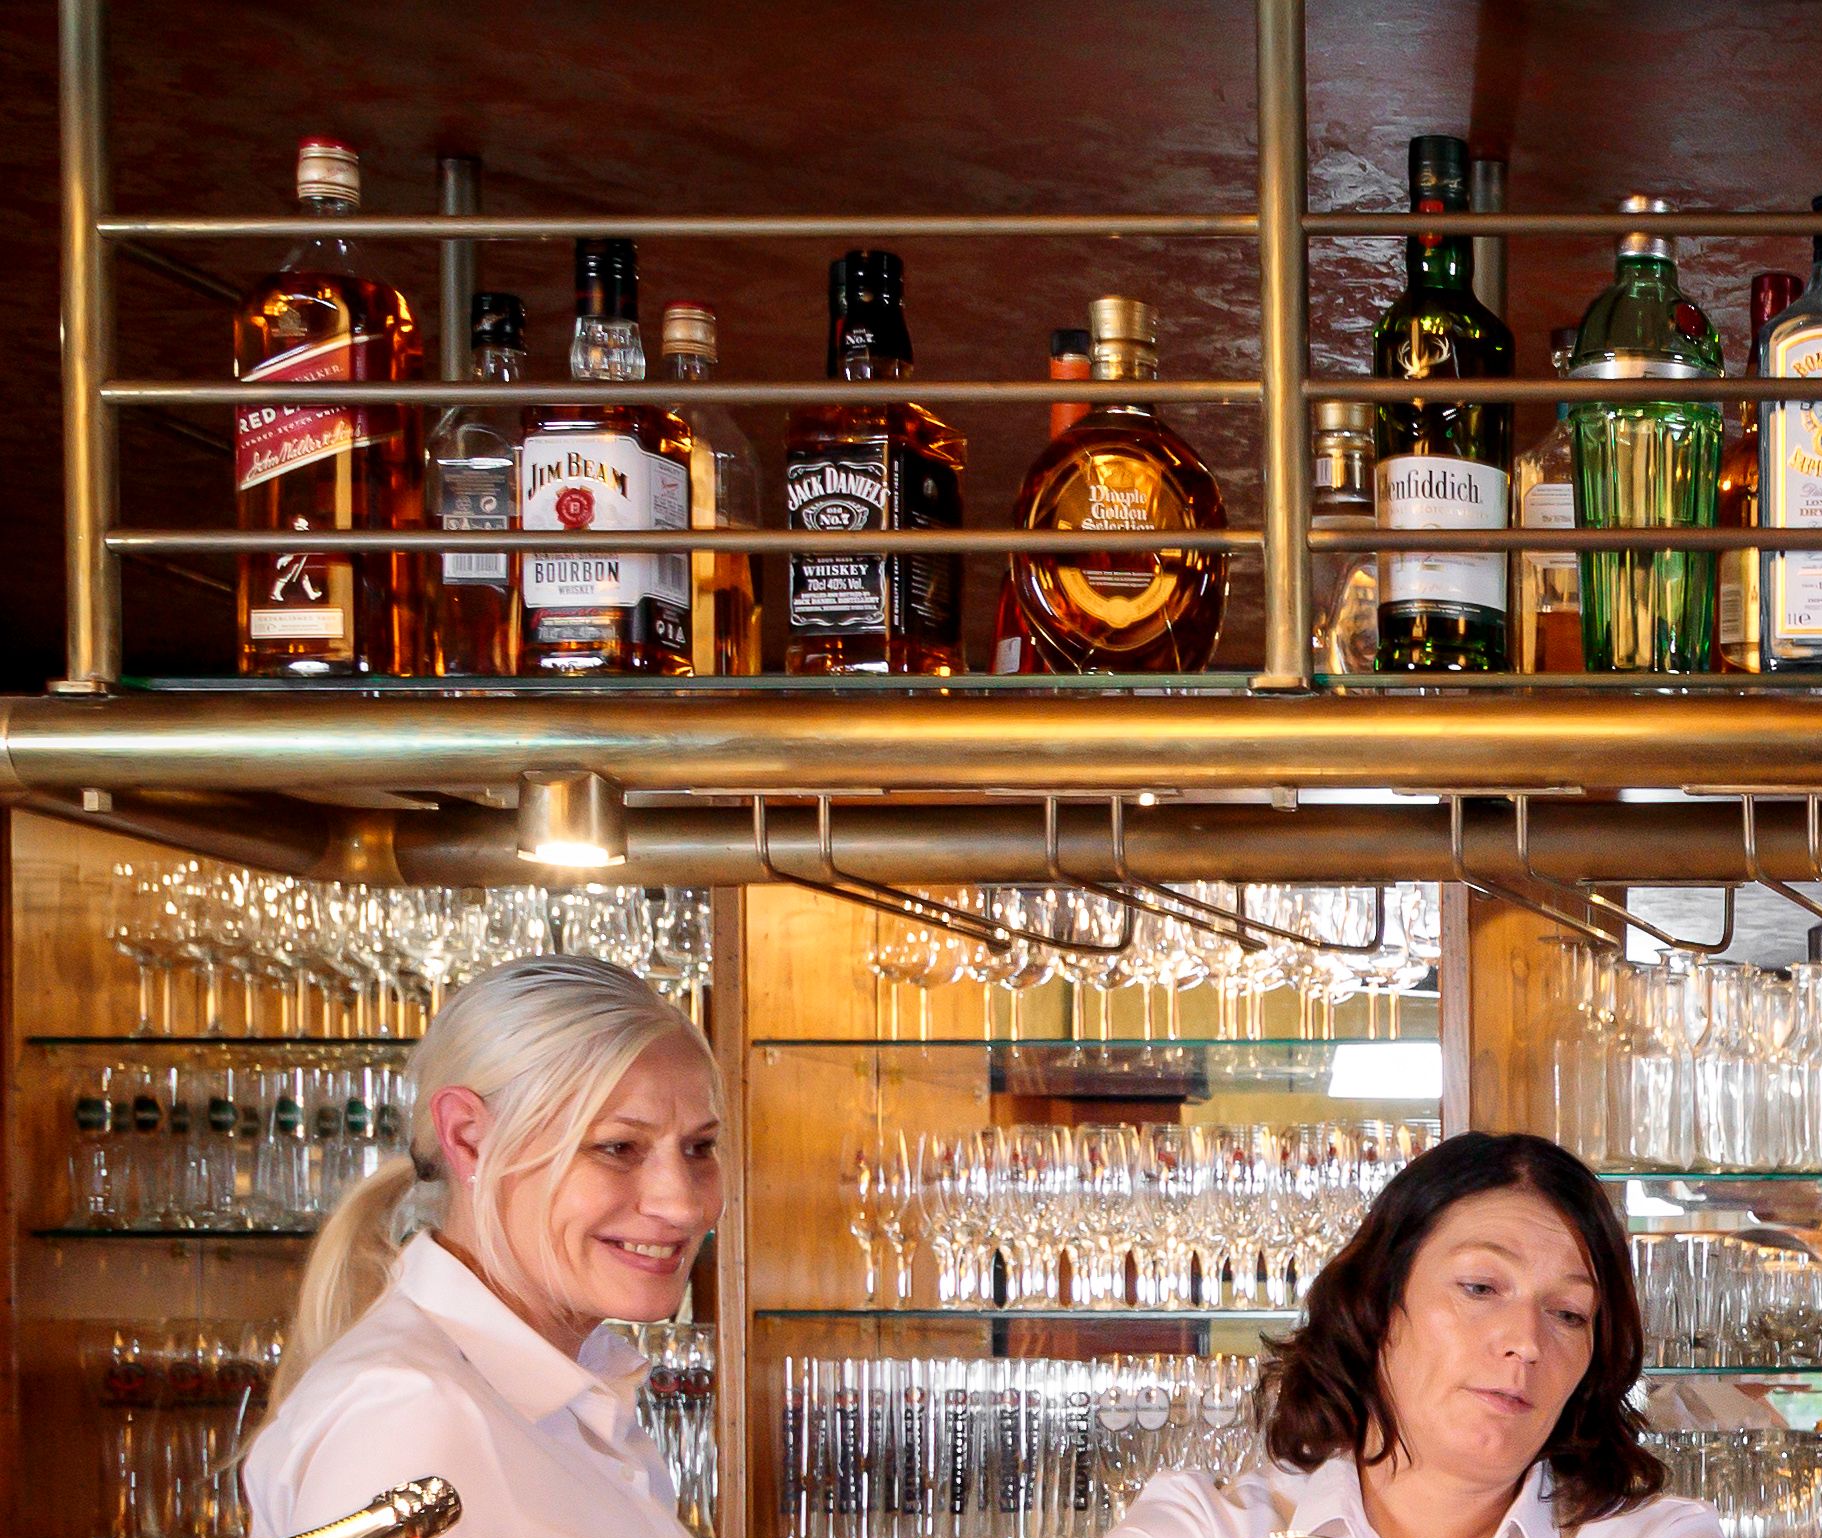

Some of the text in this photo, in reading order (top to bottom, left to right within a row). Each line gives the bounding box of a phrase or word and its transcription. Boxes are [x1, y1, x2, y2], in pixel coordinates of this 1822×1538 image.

[238, 407, 277, 435] RED
[528, 461, 562, 501] JIM
[566, 451, 631, 502] BEAM
[788, 475, 826, 511] JACK
[825, 467, 891, 510] DANIEL'S
[1088, 484, 1148, 505] Dimple
[1091, 502, 1148, 521] Golden
[535, 561, 619, 584] BOURBON
[803, 564, 869, 577] WHISKEY
